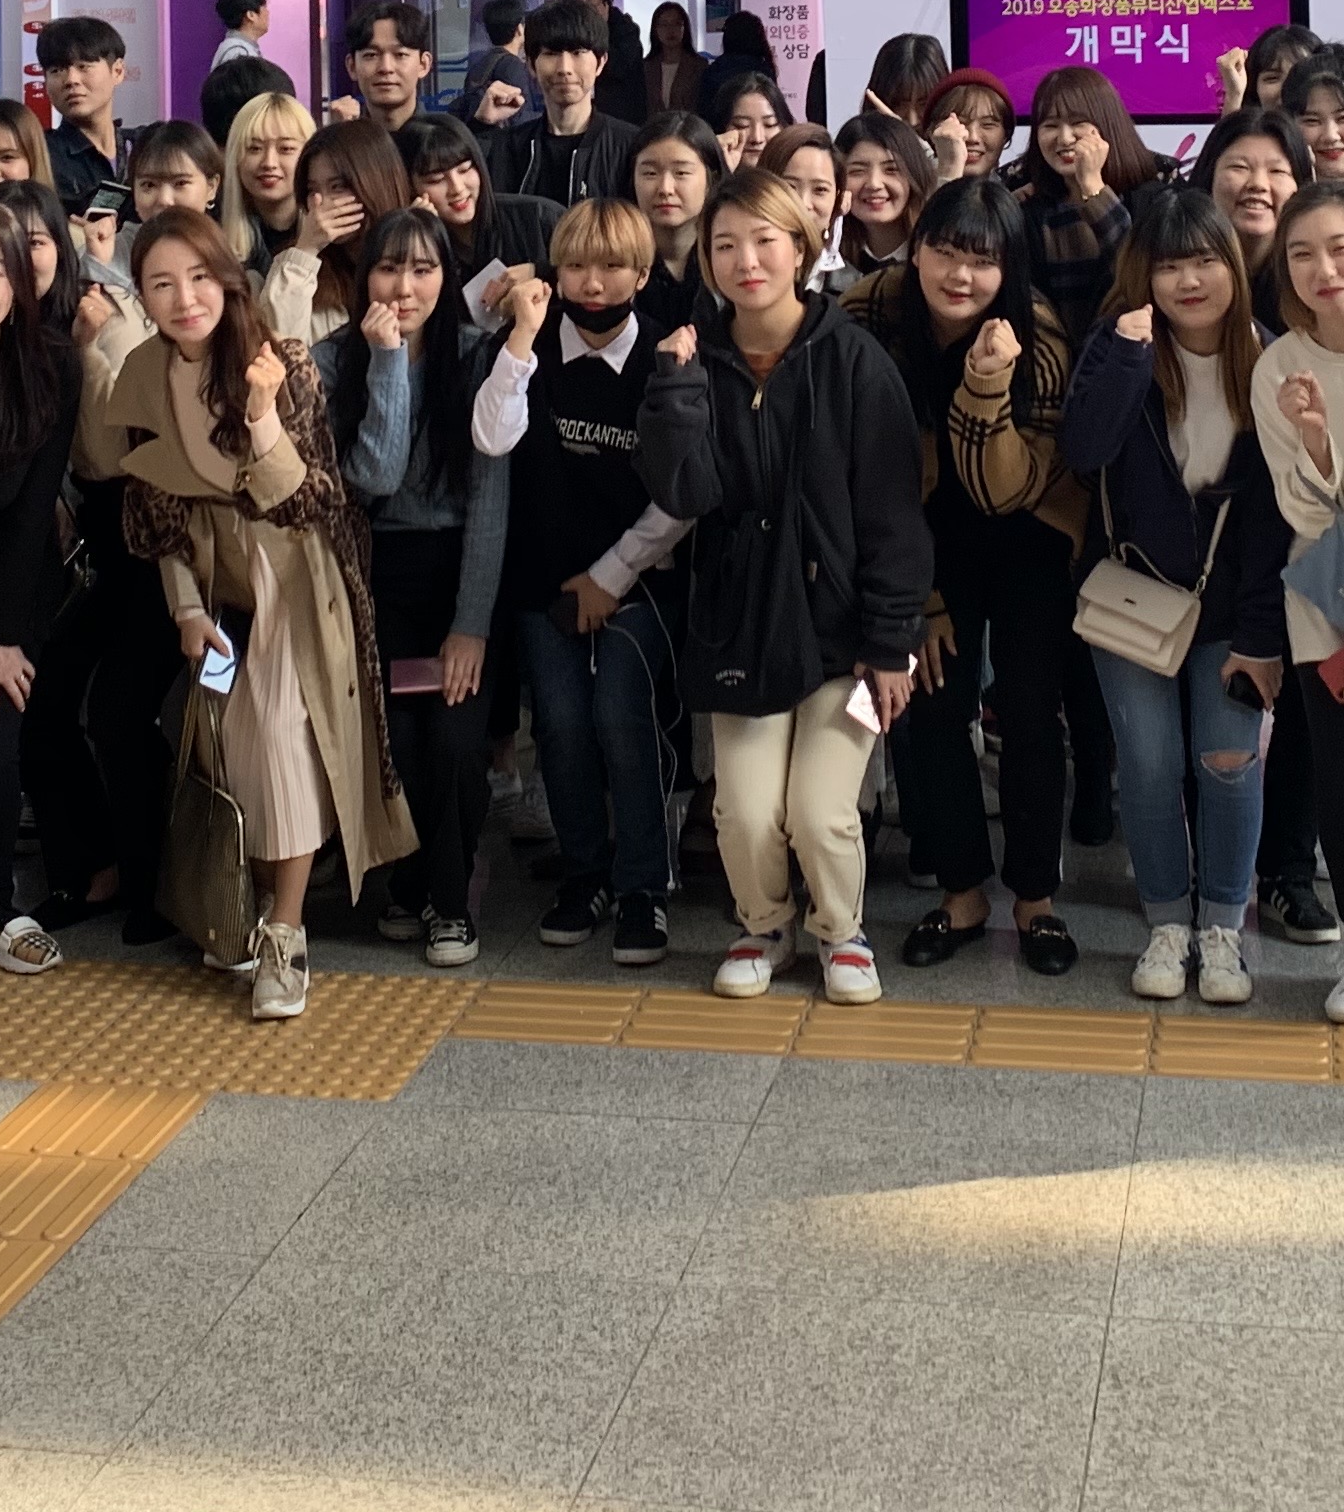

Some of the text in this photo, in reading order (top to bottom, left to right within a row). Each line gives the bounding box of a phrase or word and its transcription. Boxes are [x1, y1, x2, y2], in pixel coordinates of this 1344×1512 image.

[768, 4, 809, 20] 화장품
[765, 24, 810, 40] 외인증
[782, 44, 810, 60] 상담
